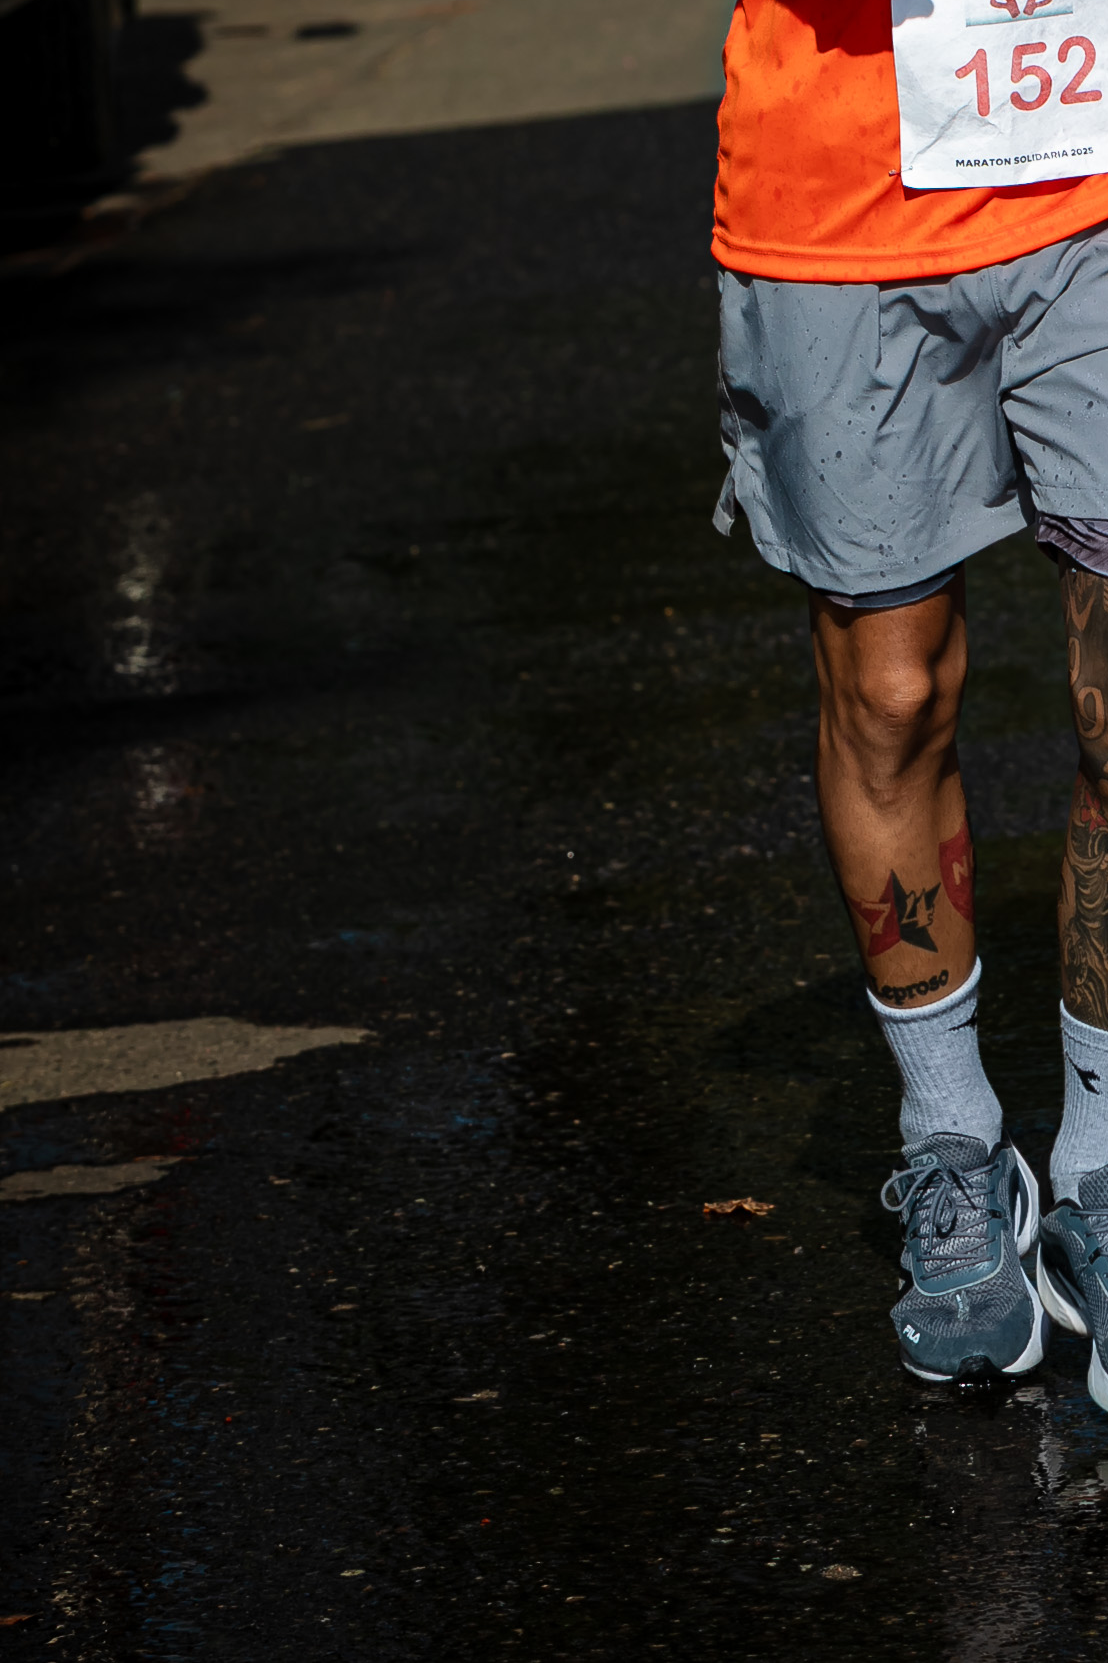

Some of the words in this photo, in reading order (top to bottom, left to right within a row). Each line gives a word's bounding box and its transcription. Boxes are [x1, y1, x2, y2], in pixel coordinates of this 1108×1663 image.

[955, 35, 1103, 117] 152
[955, 157, 1011, 168] MARATON
[1013, 149, 1069, 165] SOLIDARIA
[1070, 146, 1094, 157] 2025
[913, 1155, 935, 1168] FILA
[903, 1324, 921, 1344] FILA
